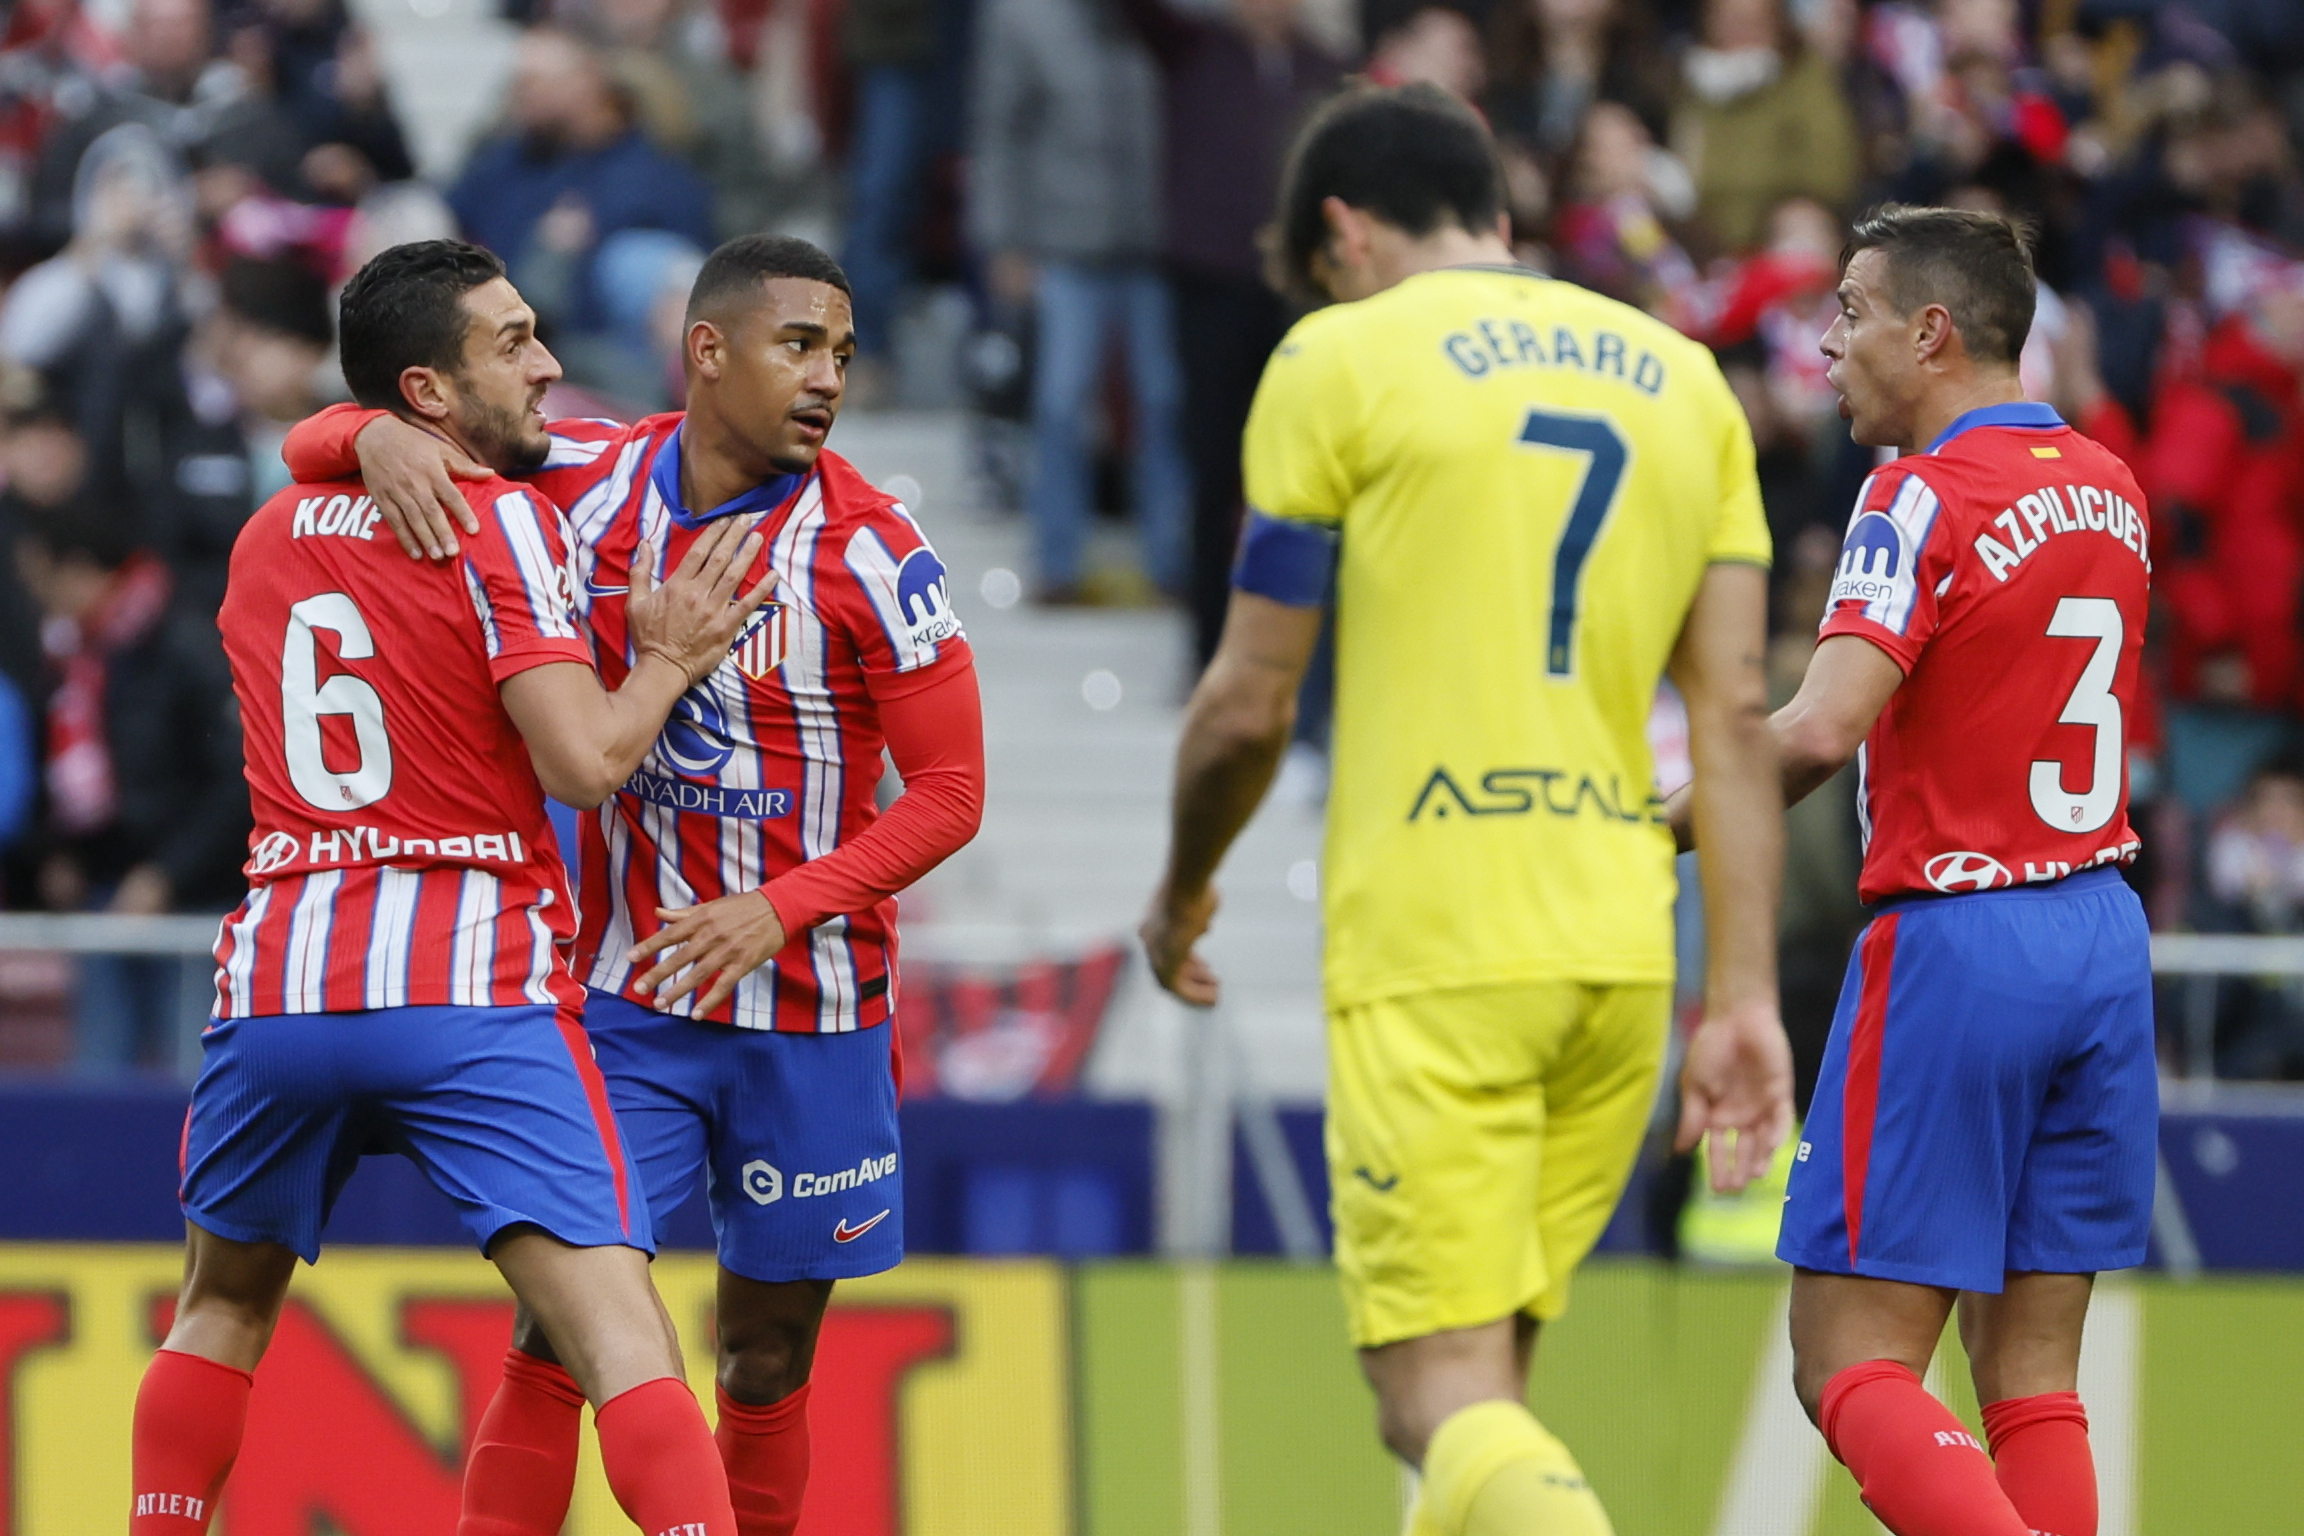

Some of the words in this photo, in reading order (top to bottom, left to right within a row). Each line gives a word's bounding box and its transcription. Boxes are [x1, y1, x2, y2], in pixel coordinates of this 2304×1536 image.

[1443, 318, 1665, 398] GERARD
[292, 494, 382, 541] KOKE
[1515, 407, 1629, 679] 7
[280, 592, 393, 813] 6
[2028, 596, 2126, 834] 3
[734, 792, 786, 816] AIR
[309, 825, 524, 863] HYUNDAI
[793, 1152, 897, 1198] ComAve
[136, 1493, 205, 1521] ATLETI
